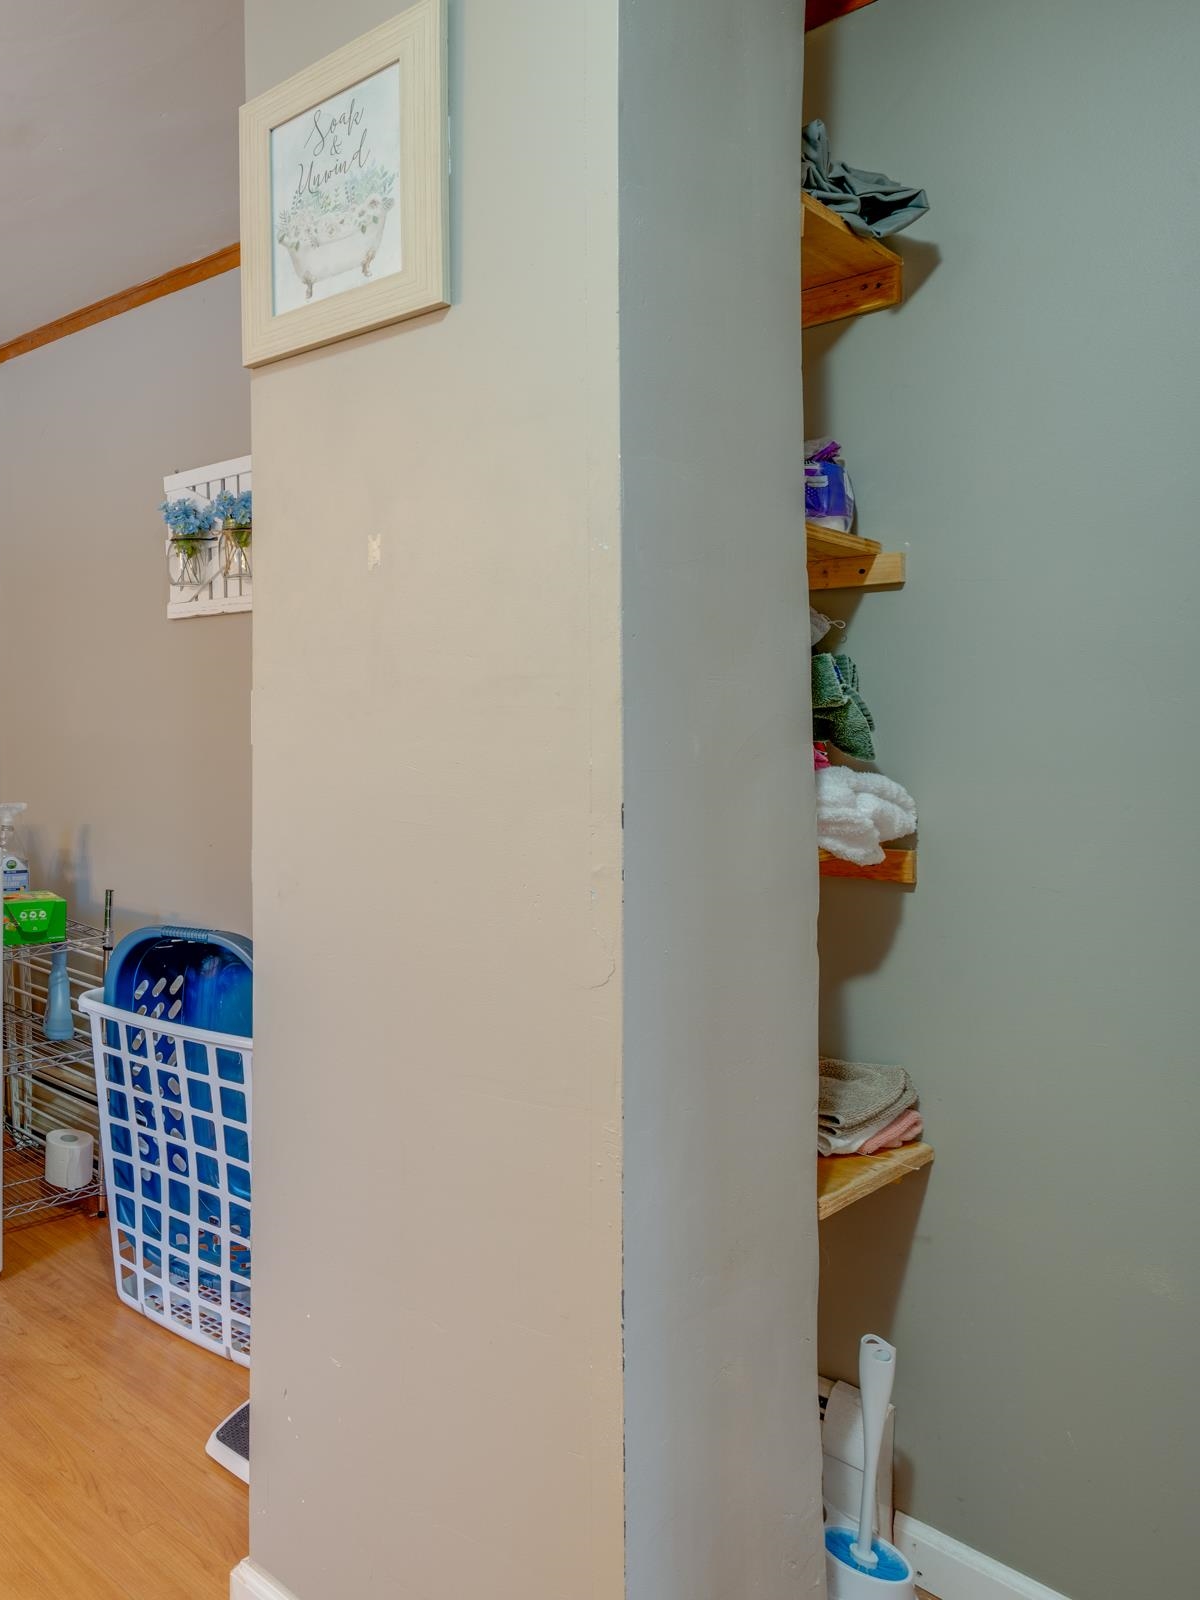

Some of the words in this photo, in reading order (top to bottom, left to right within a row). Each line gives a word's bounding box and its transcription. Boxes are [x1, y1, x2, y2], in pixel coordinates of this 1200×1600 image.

[304, 98, 365, 156] Soak
[329, 135, 343, 156] &
[297, 129, 371, 194] Unwind
